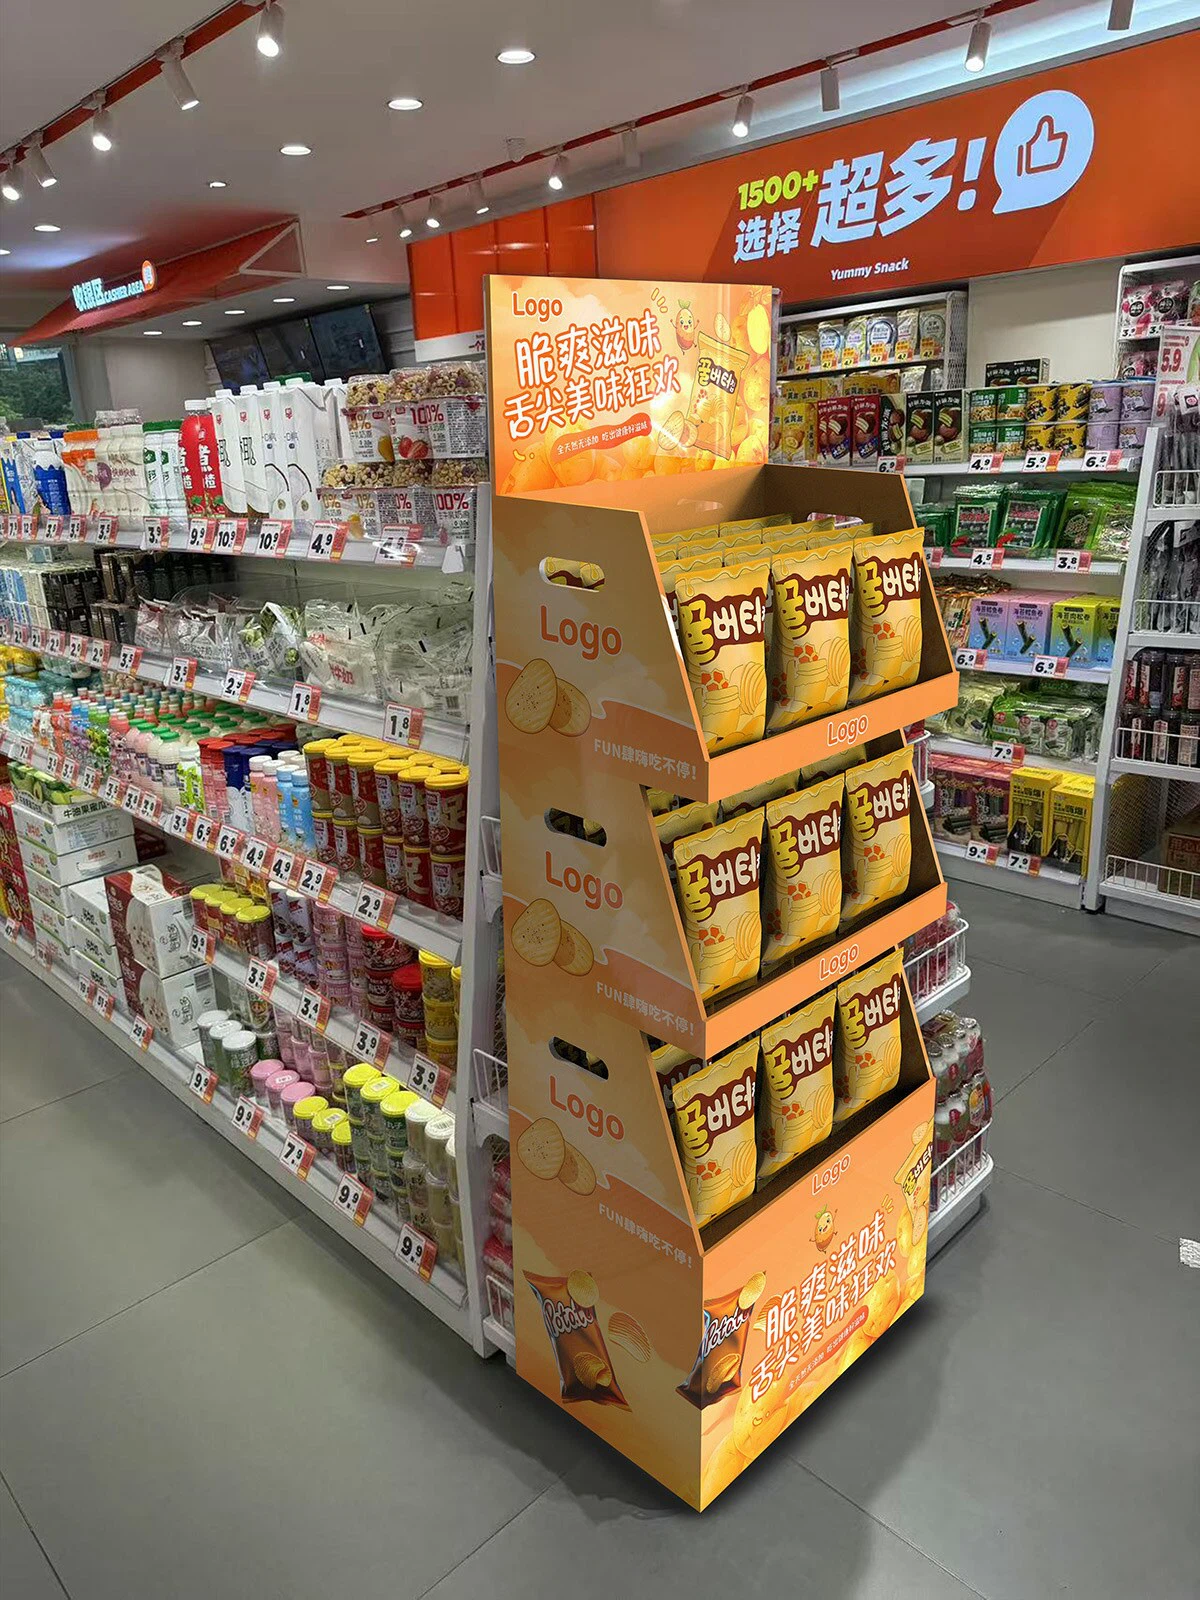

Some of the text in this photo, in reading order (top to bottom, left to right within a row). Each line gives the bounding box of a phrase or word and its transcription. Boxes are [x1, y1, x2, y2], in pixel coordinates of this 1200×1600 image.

[738, 170, 818, 210] 1500+
[733, 208, 801, 264] 选择
[831, 257, 909, 282] Yummy Snack
[128, 280, 145, 296] AREA
[512, 293, 563, 322] Logo
[515, 308, 661, 389] 脆爽滋味
[1161, 348, 1182, 373] 5.9
[504, 355, 681, 439] 舌尖美味狂欢
[879, 462, 895, 473] 6.9
[971, 458, 990, 471] 4.9
[1025, 456, 1046, 469] 5.9
[1085, 456, 1106, 468] 6.5
[98, 523, 110, 540] 3.5
[148, 526, 160, 544] 3.9
[190, 527, 205, 546] 9.9
[219, 531, 235, 547] 10.9
[259, 532, 278, 550] 10.9
[311, 533, 332, 555] 4.9
[973, 553, 991, 565] 4.5
[1057, 556, 1077, 570] 3.8
[857, 559, 922, 617] 꿀버터
[775, 575, 850, 638] 꿀버터
[540, 604, 623, 660] Logo
[680, 596, 766, 665] 꿀버터
[120, 651, 134, 669] 3.5
[956, 653, 974, 666] 6.9
[1034, 661, 1054, 674] 6.9
[174, 664, 188, 681] 3.5
[294, 692, 310, 713] 1.8
[390, 714, 410, 738] 1.8
[827, 714, 868, 746] Logo
[994, 747, 1011, 759] 7.9
[63, 799, 113, 818] 牛油果蜜瓜
[848, 778, 911, 841] 꿀버터
[173, 814, 187, 833] 3.9
[196, 823, 211, 842] 6.9
[220, 834, 236, 853] 6.9
[769, 809, 842, 878] 꿀버터
[969, 846, 986, 858] 9.4
[246, 846, 264, 867] 4.9
[1010, 856, 1028, 868] 7.9
[272, 858, 291, 879] 4.9
[301, 869, 322, 892] 2.9
[545, 851, 623, 910] Logo
[677, 845, 761, 922] 꿀버터
[358, 894, 380, 918] 2.9
[819, 944, 860, 981] Logo
[248, 966, 265, 987] 3.5
[301, 997, 318, 1018] 3.4
[840, 981, 901, 1048] 꿀버터
[357, 1030, 377, 1055] 3.9
[765, 1025, 834, 1099] 꿀버터
[193, 1073, 209, 1092] 9.9
[413, 1064, 435, 1091] 3.9
[235, 1105, 252, 1126] 9.9
[549, 1075, 625, 1141] Logo
[676, 1075, 756, 1158] 꿀버터
[284, 1142, 303, 1165] 7.9
[811, 1154, 851, 1196] Logo
[338, 1185, 359, 1209] 9.9
[402, 1235, 423, 1262] 9.9
[765, 1210, 885, 1349] 脆爽滋味
[750, 1240, 897, 1403] 舌尖美味狂欢
